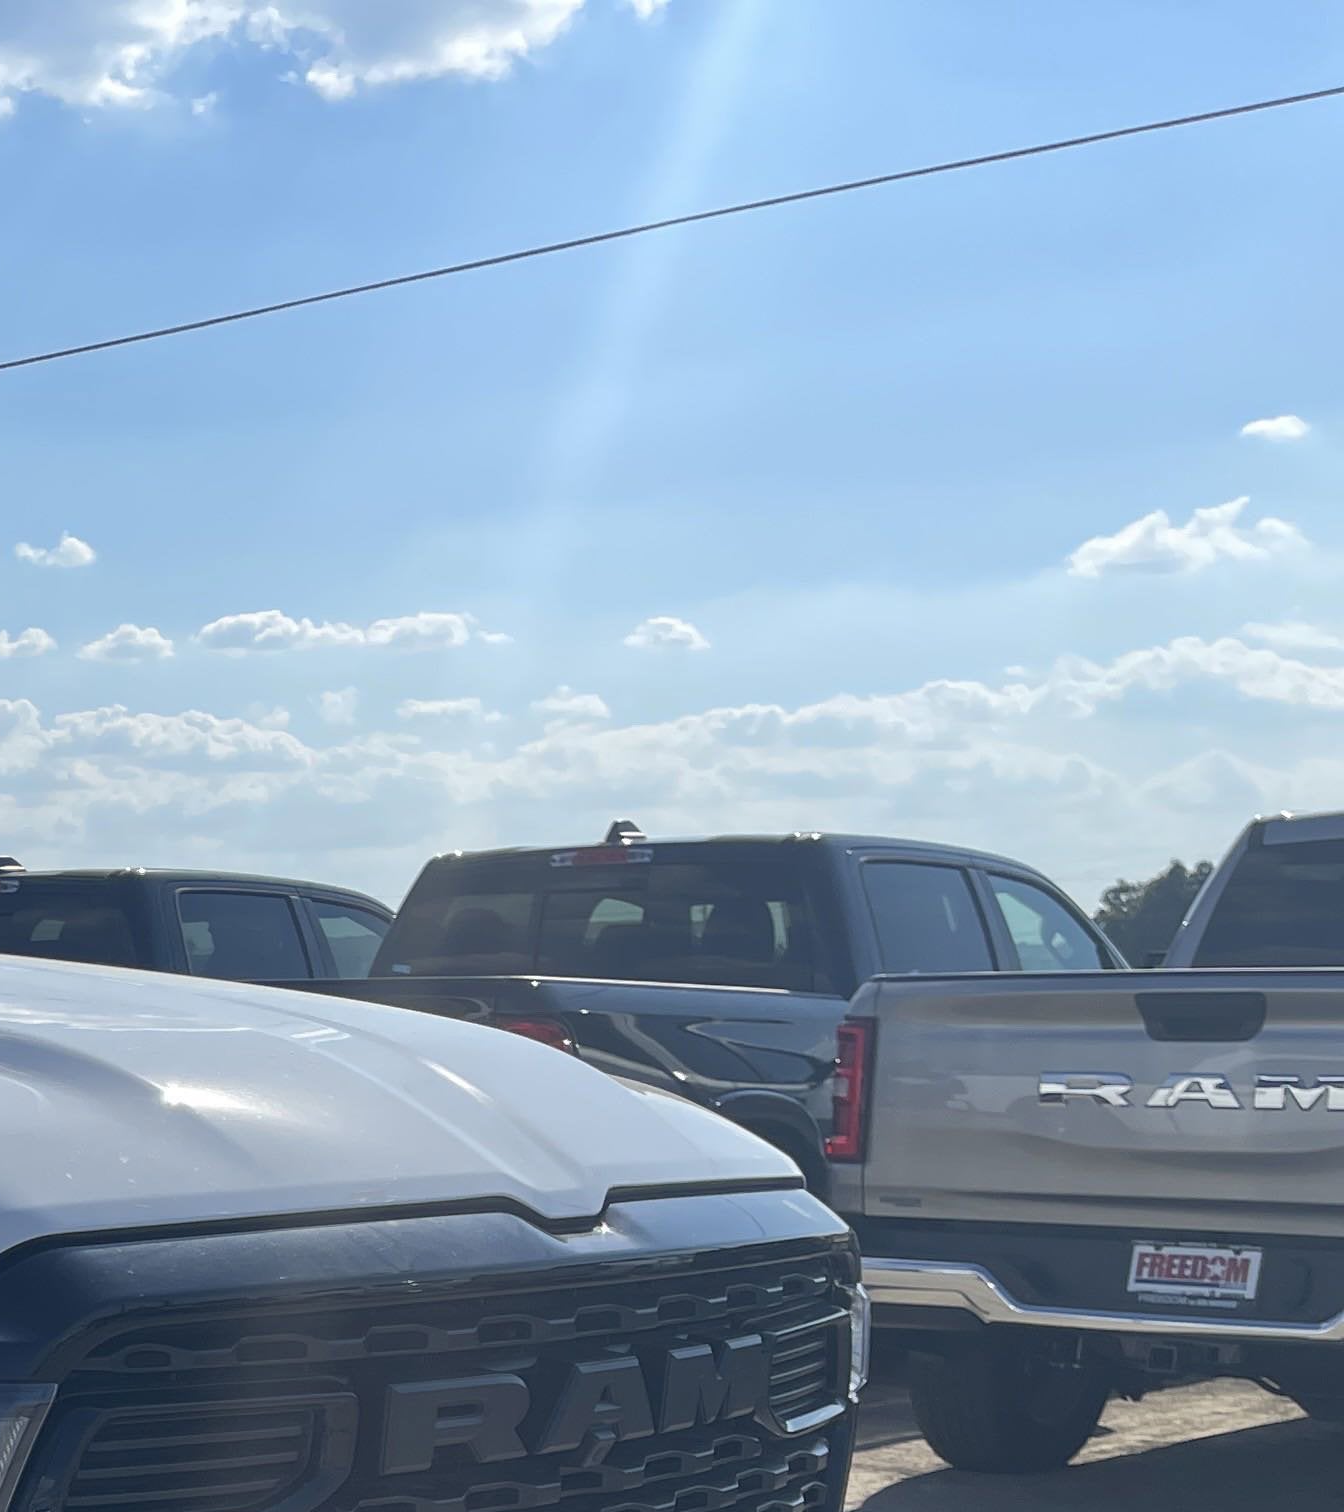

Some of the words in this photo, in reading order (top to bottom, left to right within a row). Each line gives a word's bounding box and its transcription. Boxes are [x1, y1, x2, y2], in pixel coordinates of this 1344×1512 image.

[1038, 1072, 1344, 1111] RAM
[1136, 1252, 1250, 1284] FREEDOM
[380, 1332, 771, 1474] RAM
